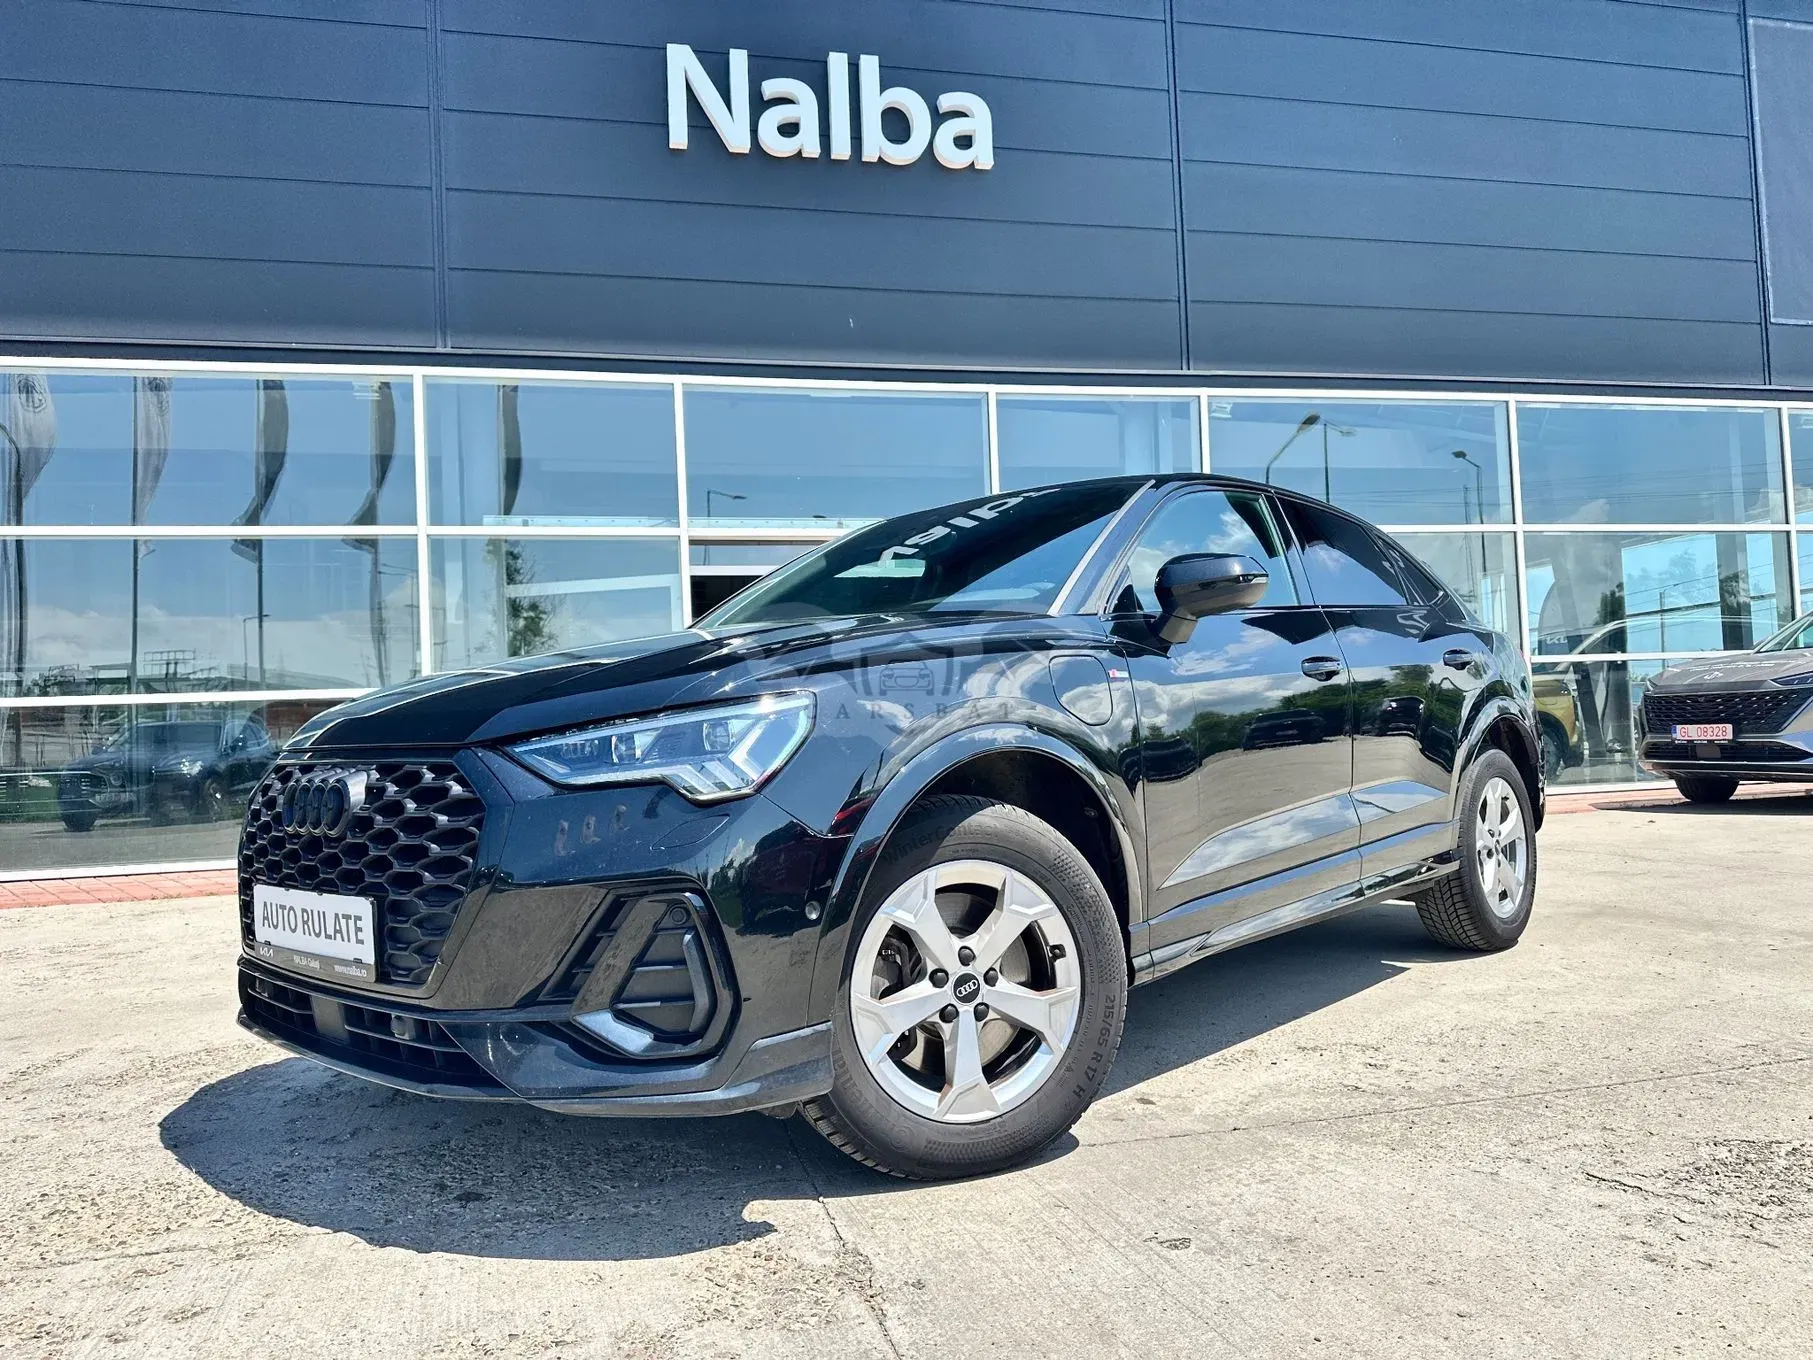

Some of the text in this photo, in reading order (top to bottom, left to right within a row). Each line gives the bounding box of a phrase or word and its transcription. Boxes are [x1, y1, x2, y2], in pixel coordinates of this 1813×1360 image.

[666, 43, 994, 170] Nalba
[1679, 725, 1727, 738] GL 08328
[262, 901, 364, 945] AUTO RULATE
[260, 947, 274, 957] KIA
[1097, 995, 1115, 1049] 215/65
